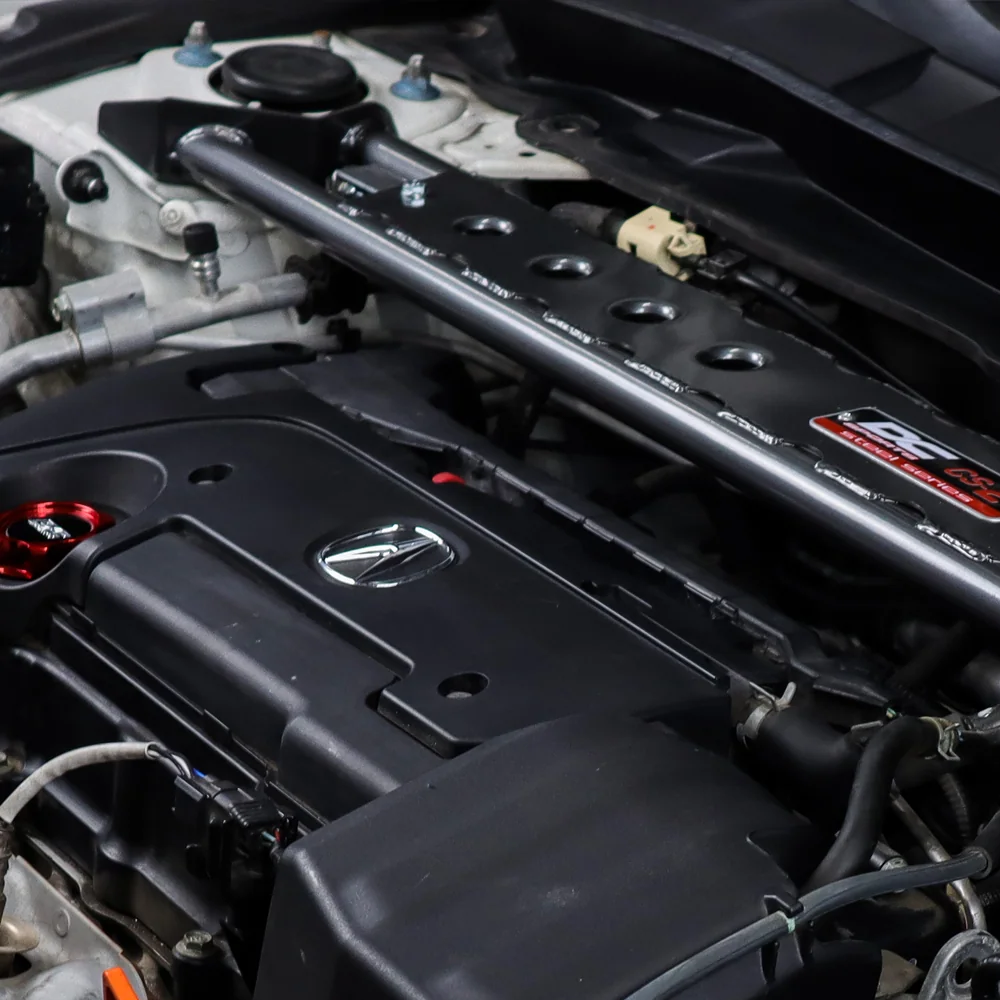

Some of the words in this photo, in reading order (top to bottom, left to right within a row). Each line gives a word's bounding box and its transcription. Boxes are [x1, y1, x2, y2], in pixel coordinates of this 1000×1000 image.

[839, 430, 899, 462] steel
[900, 462, 974, 503] series
[856, 421, 961, 460] DC
